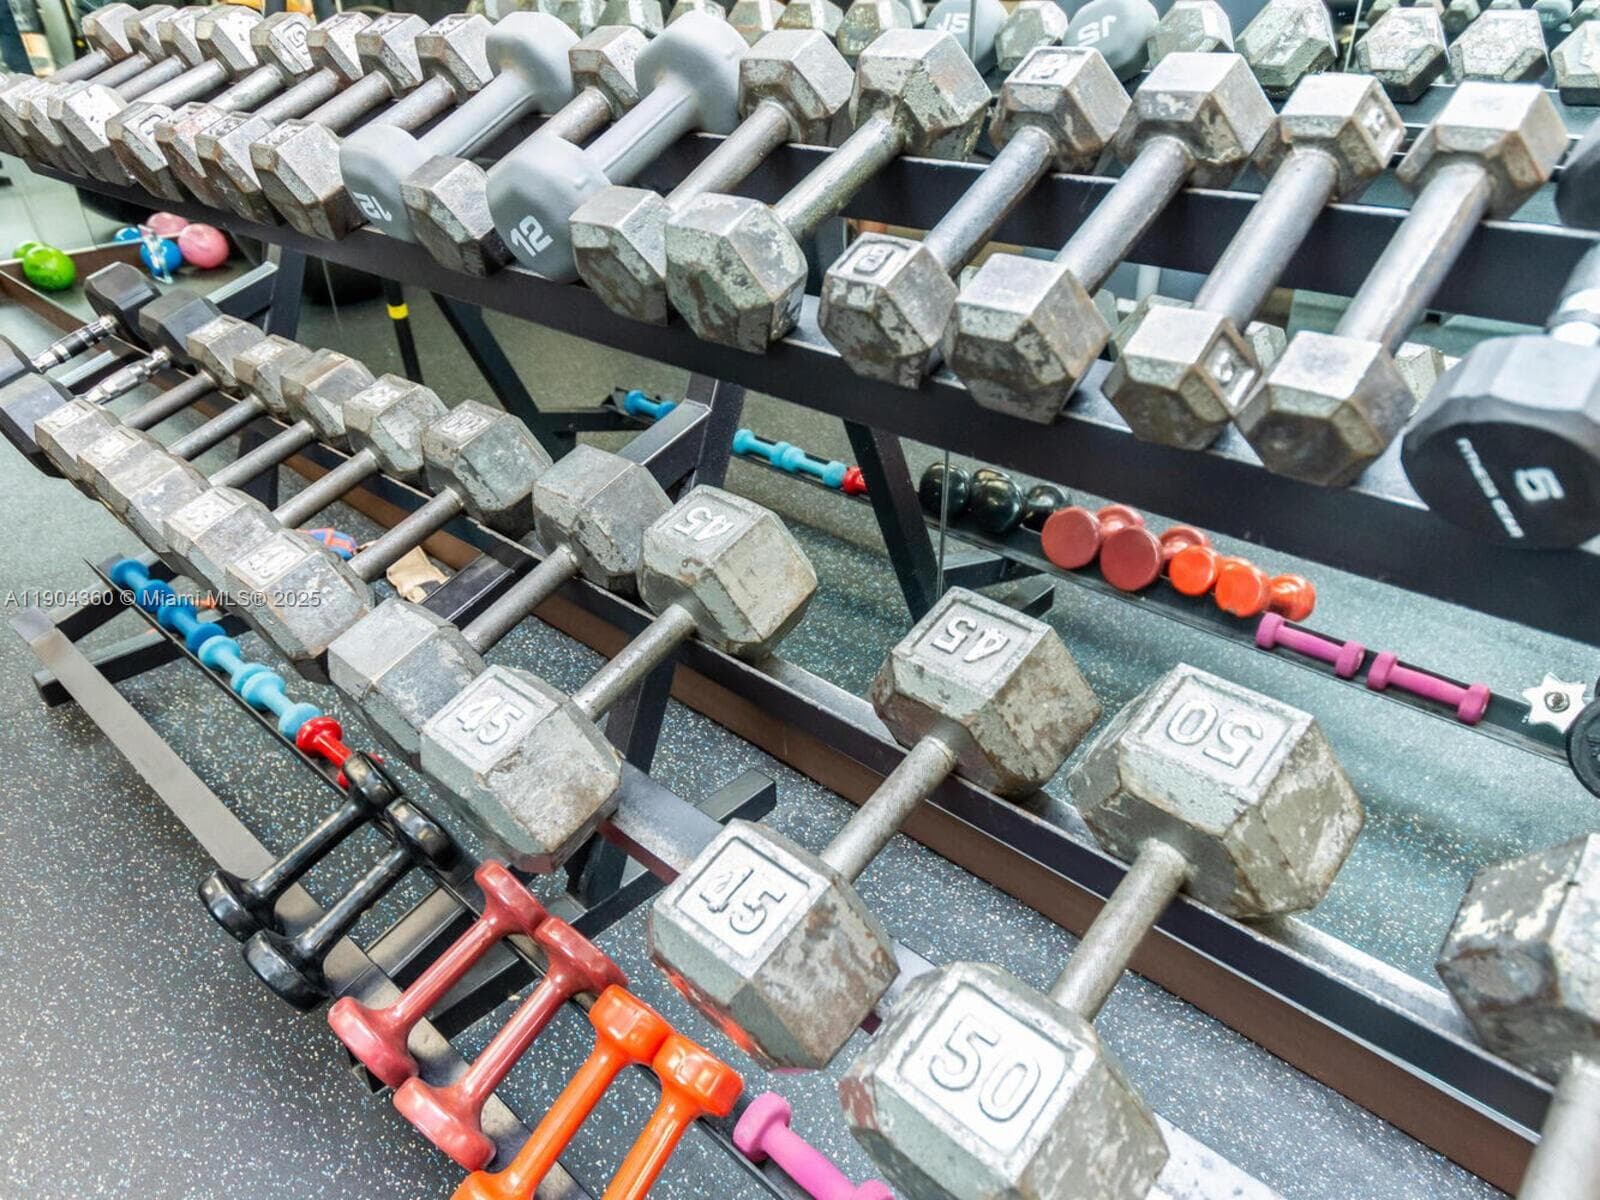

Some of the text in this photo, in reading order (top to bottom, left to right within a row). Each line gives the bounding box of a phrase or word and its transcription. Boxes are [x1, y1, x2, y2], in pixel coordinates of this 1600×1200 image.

[352, 192, 392, 222] 12
[510, 215, 554, 257] 12
[672, 506, 734, 541] 45
[931, 613, 1009, 662] 45
[456, 697, 525, 745] 45
[1166, 699, 1265, 770] 50
[699, 868, 787, 935] 45
[928, 1016, 1042, 1123] 50
